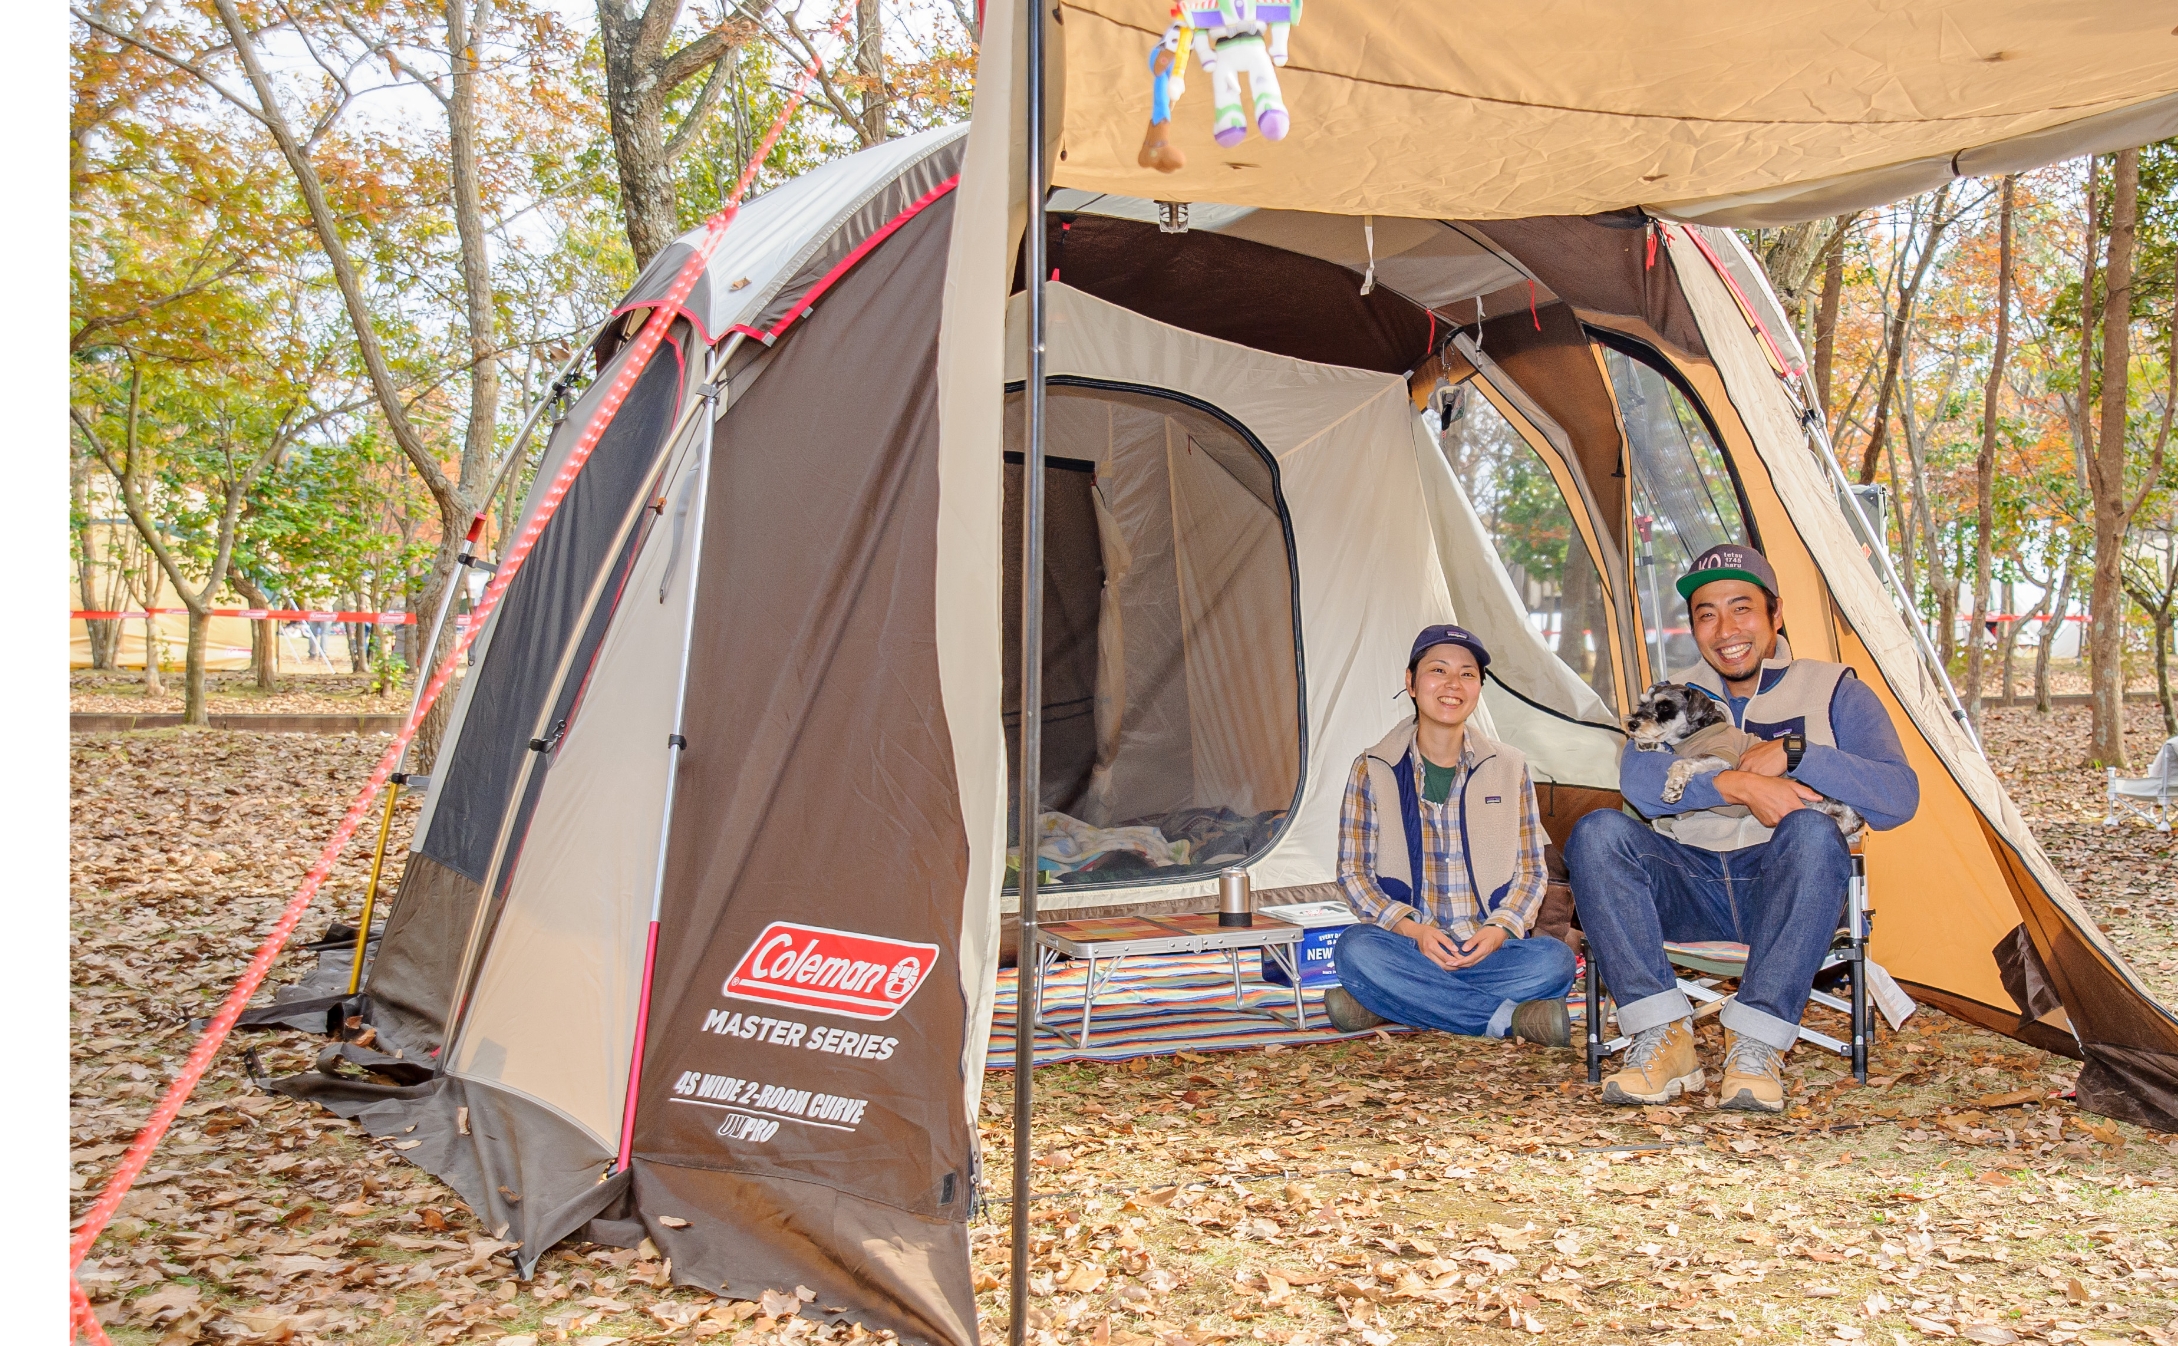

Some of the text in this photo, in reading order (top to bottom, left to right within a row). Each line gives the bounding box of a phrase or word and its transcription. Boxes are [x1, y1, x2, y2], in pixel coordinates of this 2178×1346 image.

[752, 933, 887, 993] Coleman
[1307, 947, 1333, 961] NEW
[702, 1008, 899, 1060] MASTER SERIES
[674, 1071, 868, 1124] 4S WIDE 2-ROOM CURVE
